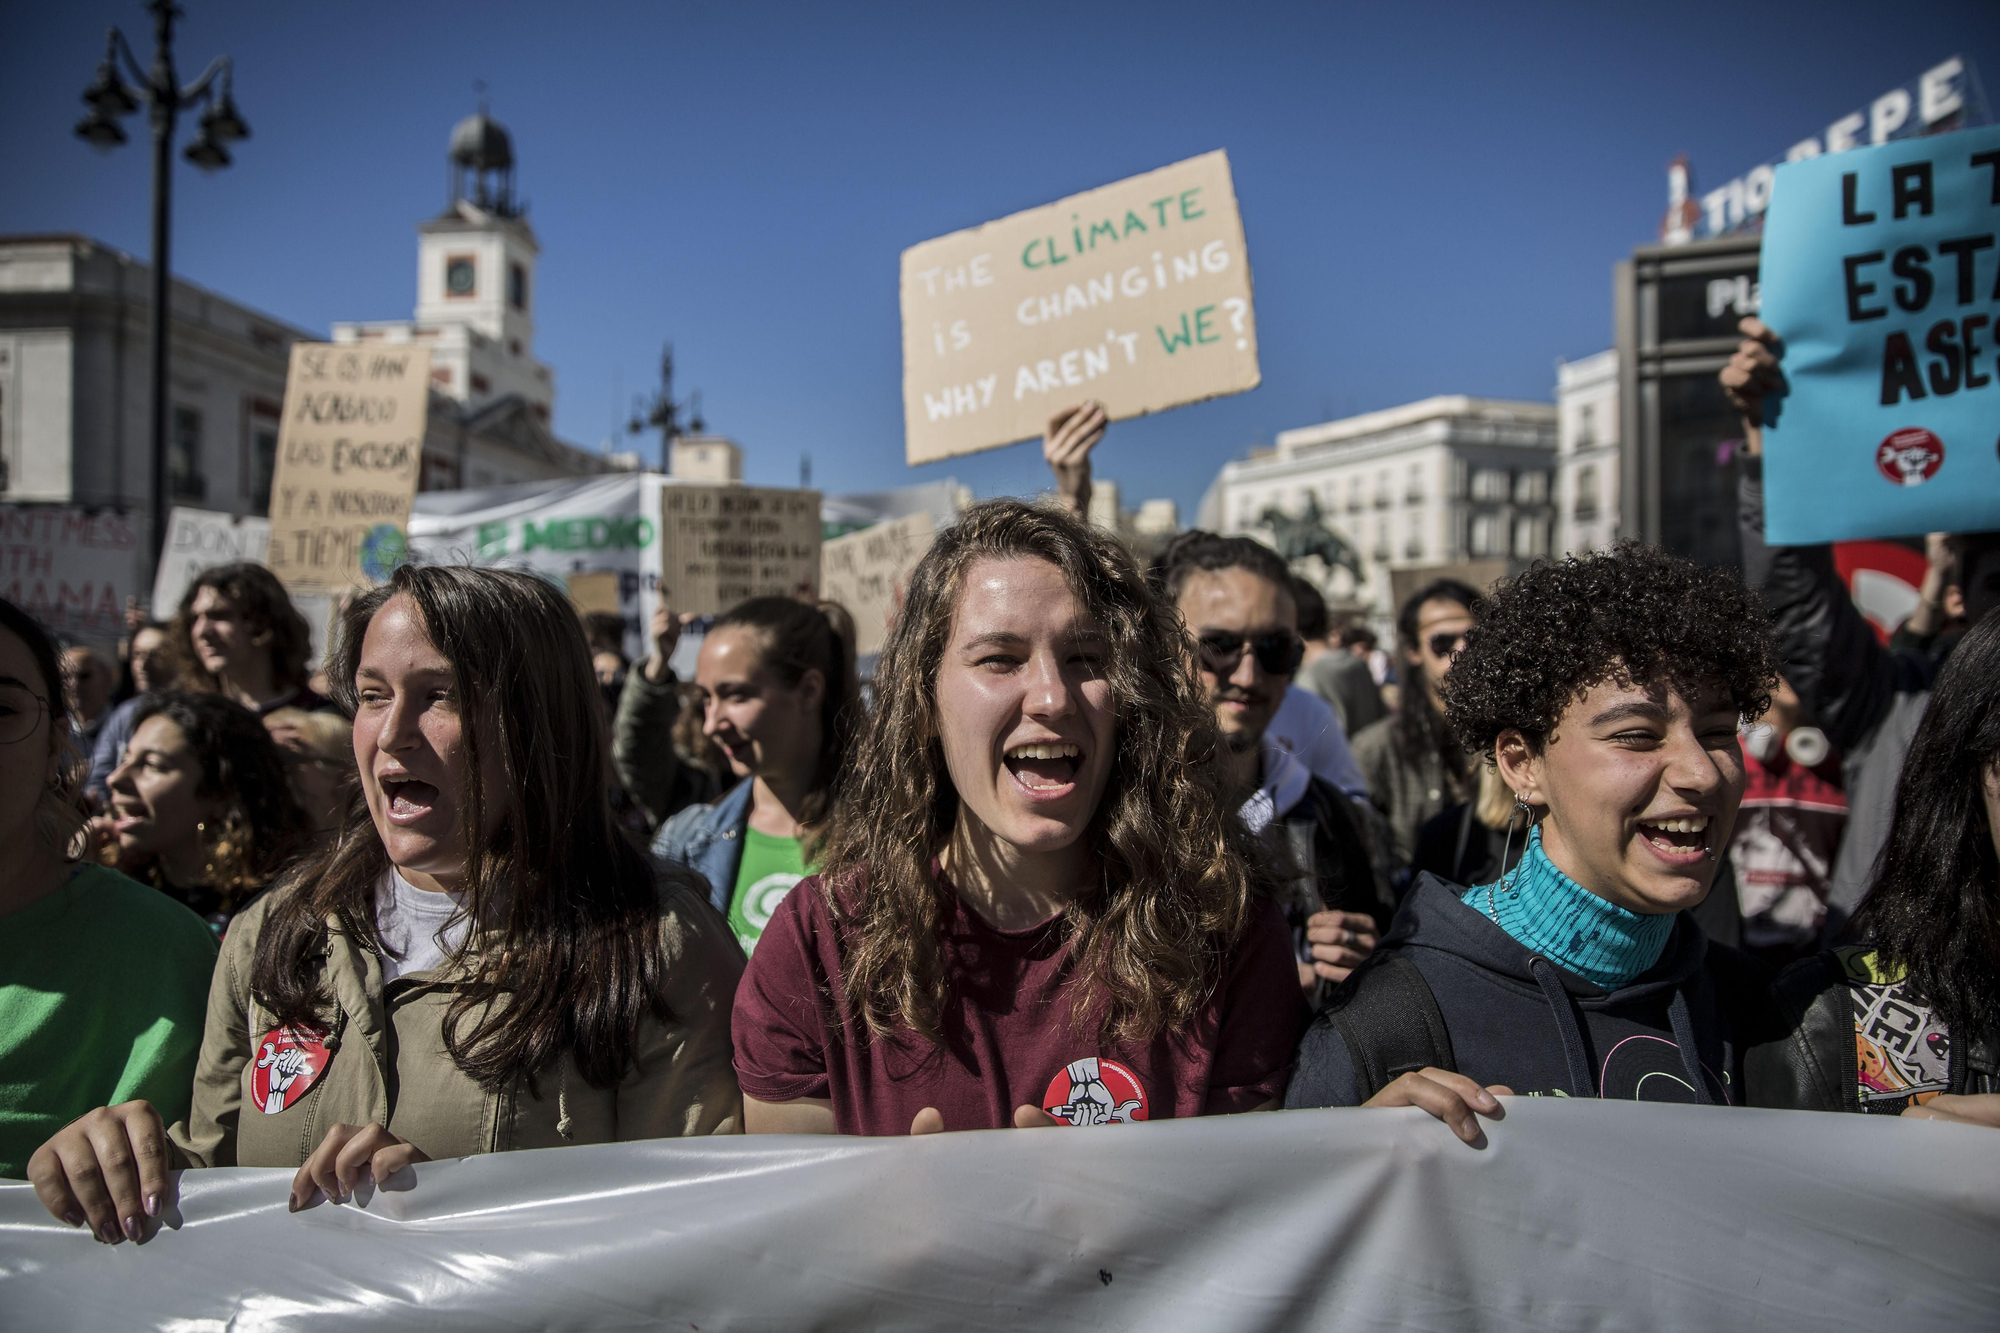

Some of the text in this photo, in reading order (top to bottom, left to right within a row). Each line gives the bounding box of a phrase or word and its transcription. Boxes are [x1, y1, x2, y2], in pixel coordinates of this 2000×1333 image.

[1842, 160, 1933, 227] LA
[916, 253, 995, 298] THE
[1843, 234, 2000, 323] EST
[924, 372, 997, 421] WHY
[1013, 328, 1140, 400] AREN'T
[1880, 313, 2000, 407] ASE
